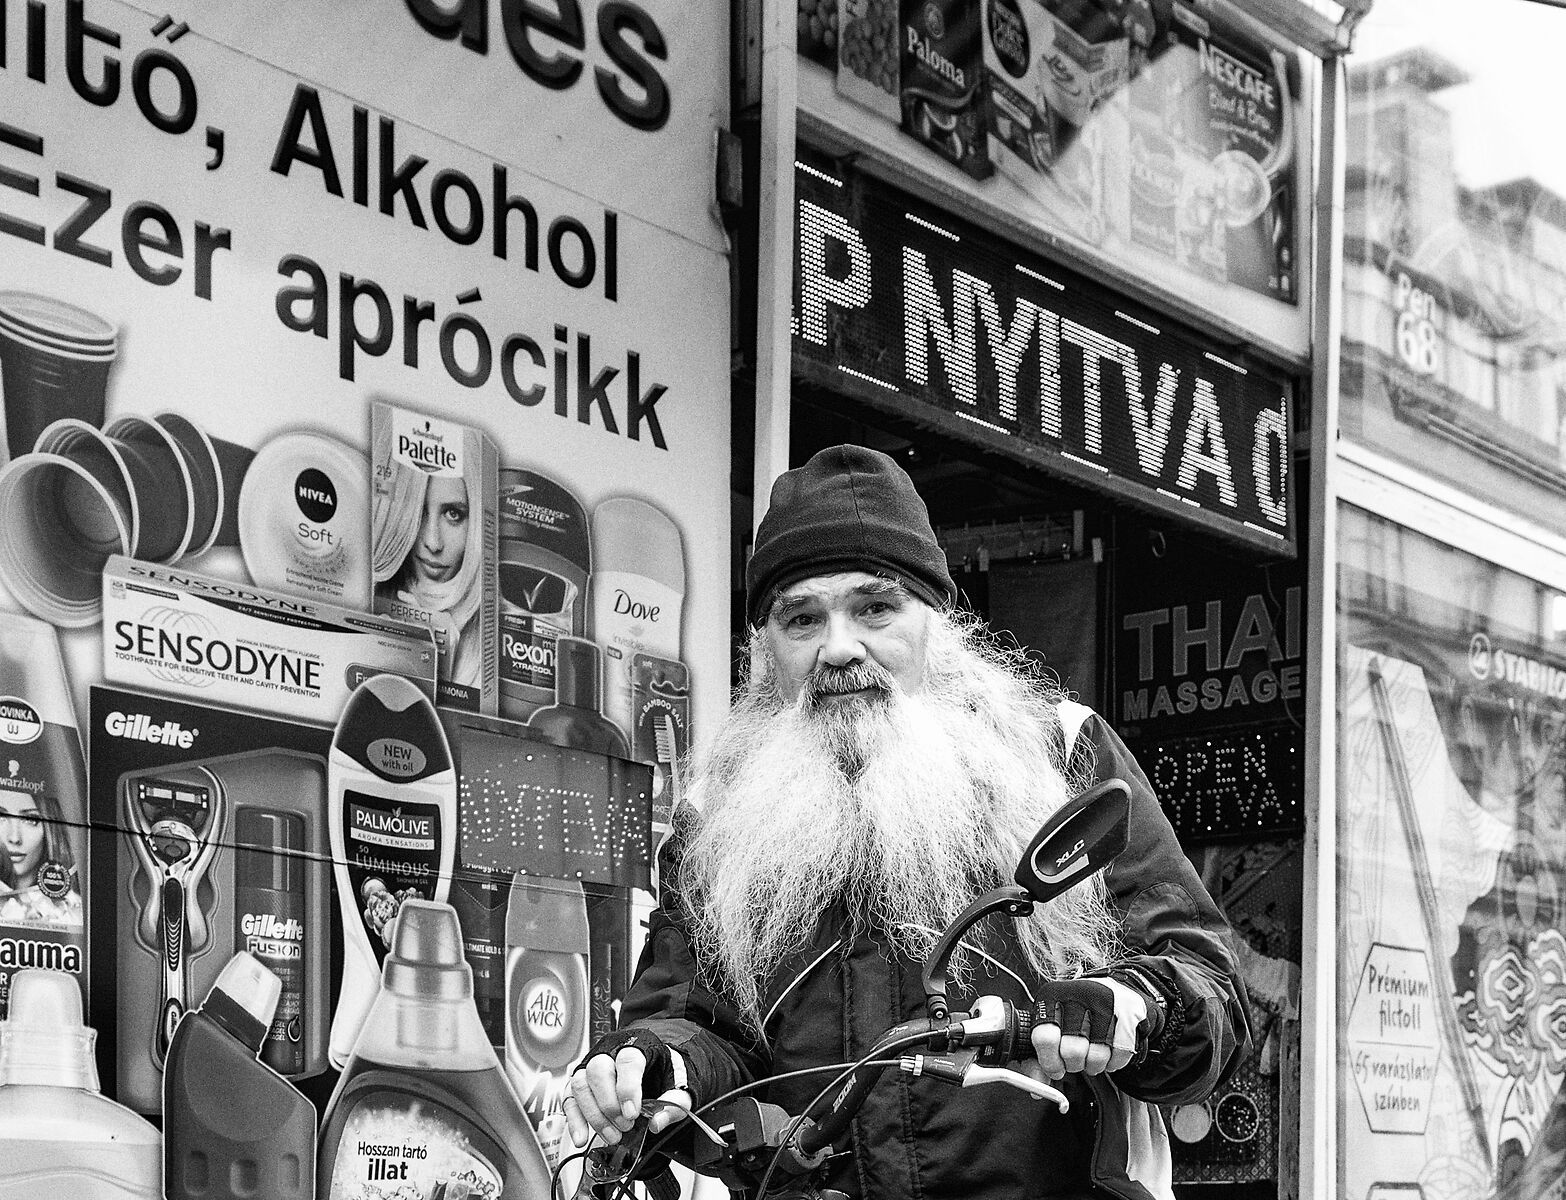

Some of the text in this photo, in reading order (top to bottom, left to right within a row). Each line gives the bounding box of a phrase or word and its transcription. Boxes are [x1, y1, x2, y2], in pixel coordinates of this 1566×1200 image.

[907, 25, 965, 88] Paloma
[270, 83, 619, 302] Alkohol
[1394, 272, 1436, 320] Pen
[275, 253, 669, 452] aprócikk
[1397, 312, 1438, 374] 68
[902, 246, 1237, 507] NYITVA
[399, 434, 457, 470] Palette
[299, 486, 334, 506] NIVEA
[515, 507, 555, 524] SYSTEM
[298, 522, 333, 545] Soft
[128, 566, 317, 616] SENSODYNE
[614, 588, 660, 623] Dove
[390, 603, 433, 622] PERFECT
[1123, 586, 1301, 681] THAI
[115, 620, 321, 690] SENSODYNE
[502, 633, 556, 667] Rexon
[115, 651, 321, 699] TOOTHPASTE FOR SENSITIVE TEETH AND CAVITY PREVENTION
[512, 660, 554, 676] XTRACOOL
[1123, 665, 1301, 722] MASSAGE
[0, 705, 34, 722] OVINKA
[642, 698, 672, 713] BAMBOO
[671, 708, 684, 729] SALT
[104, 711, 195, 750] Gillette
[382, 759, 414, 772] with oil
[384, 744, 412, 760] NEW
[1154, 743, 1267, 790] OPEN
[0, 776, 45, 794] warzkopf
[356, 809, 430, 836] PALMOLIVE
[357, 832, 430, 849] AROMA SENSATIONS
[1055, 839, 1085, 867] XLC
[355, 853, 430, 876] LUMINOUS
[241, 913, 304, 941] Gillette
[0, 940, 81, 972] auma
[1369, 964, 1430, 998] Prémium
[527, 1010, 564, 1028] WICK
[1379, 999, 1421, 1037] filctoll
[1355, 1050, 1370, 1083] 65
[833, 1072, 857, 1114] ZOOM
[1375, 1084, 1421, 1111] színben
[357, 1140, 428, 1160] Hosszan tartó
[367, 1158, 409, 1181] illat
